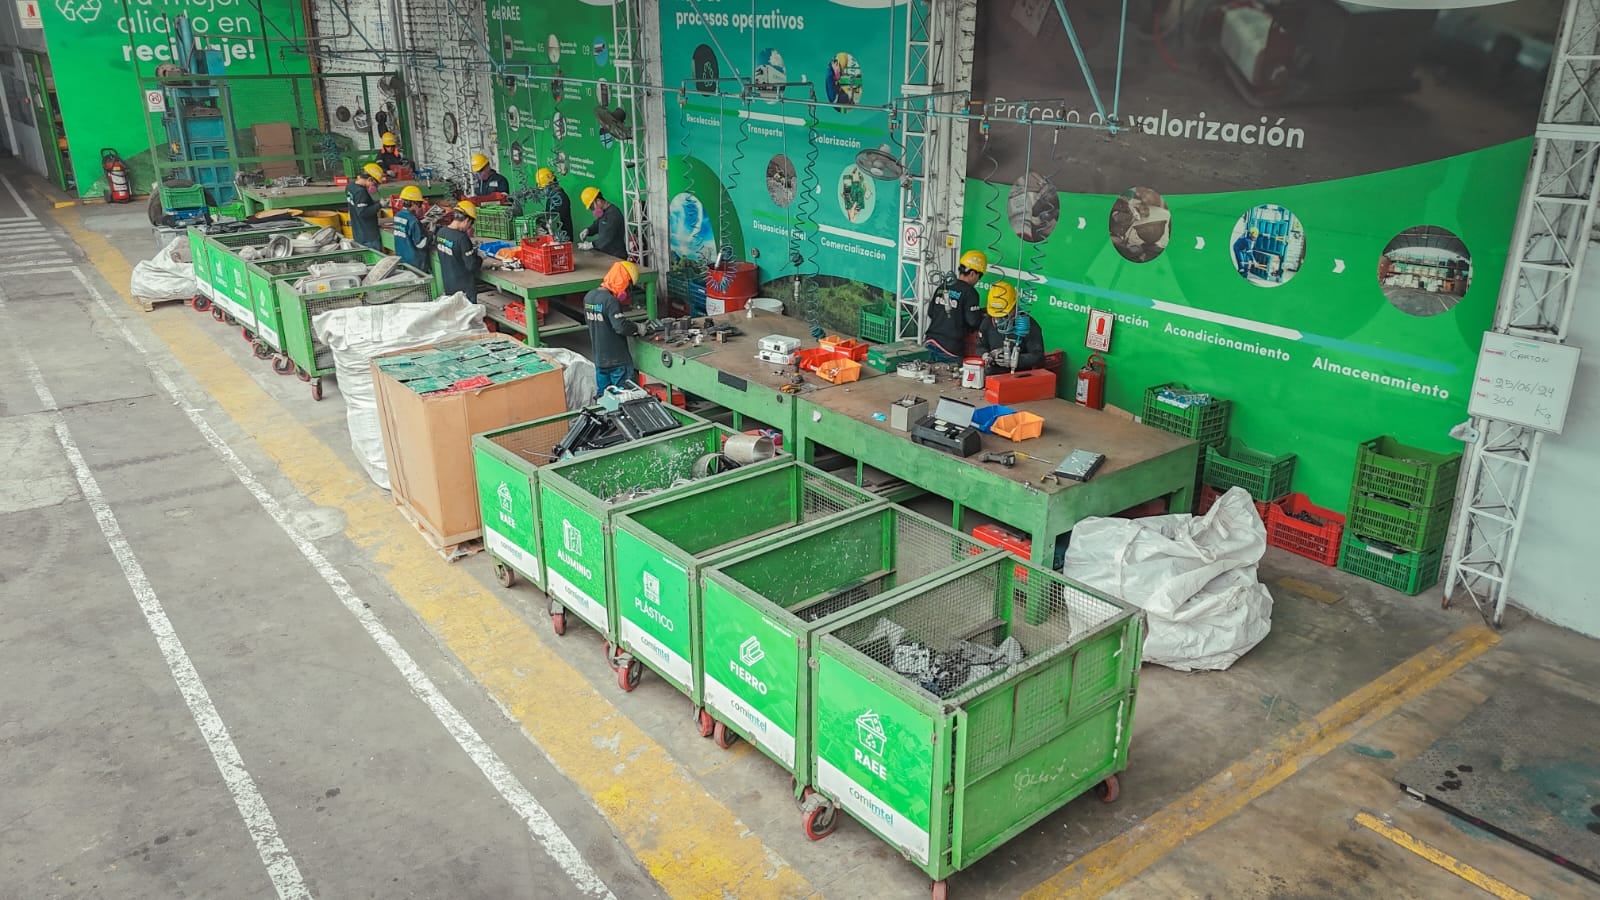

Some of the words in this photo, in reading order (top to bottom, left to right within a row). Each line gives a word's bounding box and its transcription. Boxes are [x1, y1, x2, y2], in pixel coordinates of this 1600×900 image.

[117, 9, 209, 34] aliao
[218, 16, 252, 33] en
[501, 5, 520, 21] RAEE
[675, 11, 729, 30] procesos
[731, 8, 804, 33] operativos
[122, 37, 256, 66] recilje!
[686, 113, 721, 127] Recolección
[747, 123, 783, 138] Transporte
[1128, 108, 1305, 149] valorización
[753, 219, 788, 235] Disposición
[820, 236, 886, 261] Comercialización
[1049, 295, 1151, 328] Descontnación
[1164, 322, 1291, 362] Acondicionamiento
[1312, 356, 1449, 399] Almacenamiento
[557, 549, 592, 580] ALUMINIO
[640, 635, 670, 663] comimtel
[730, 660, 768, 696] FIERRO
[730, 699, 767, 734] comimtel
[854, 747, 888, 781] RAEE
[849, 786, 894, 826] comimtel
